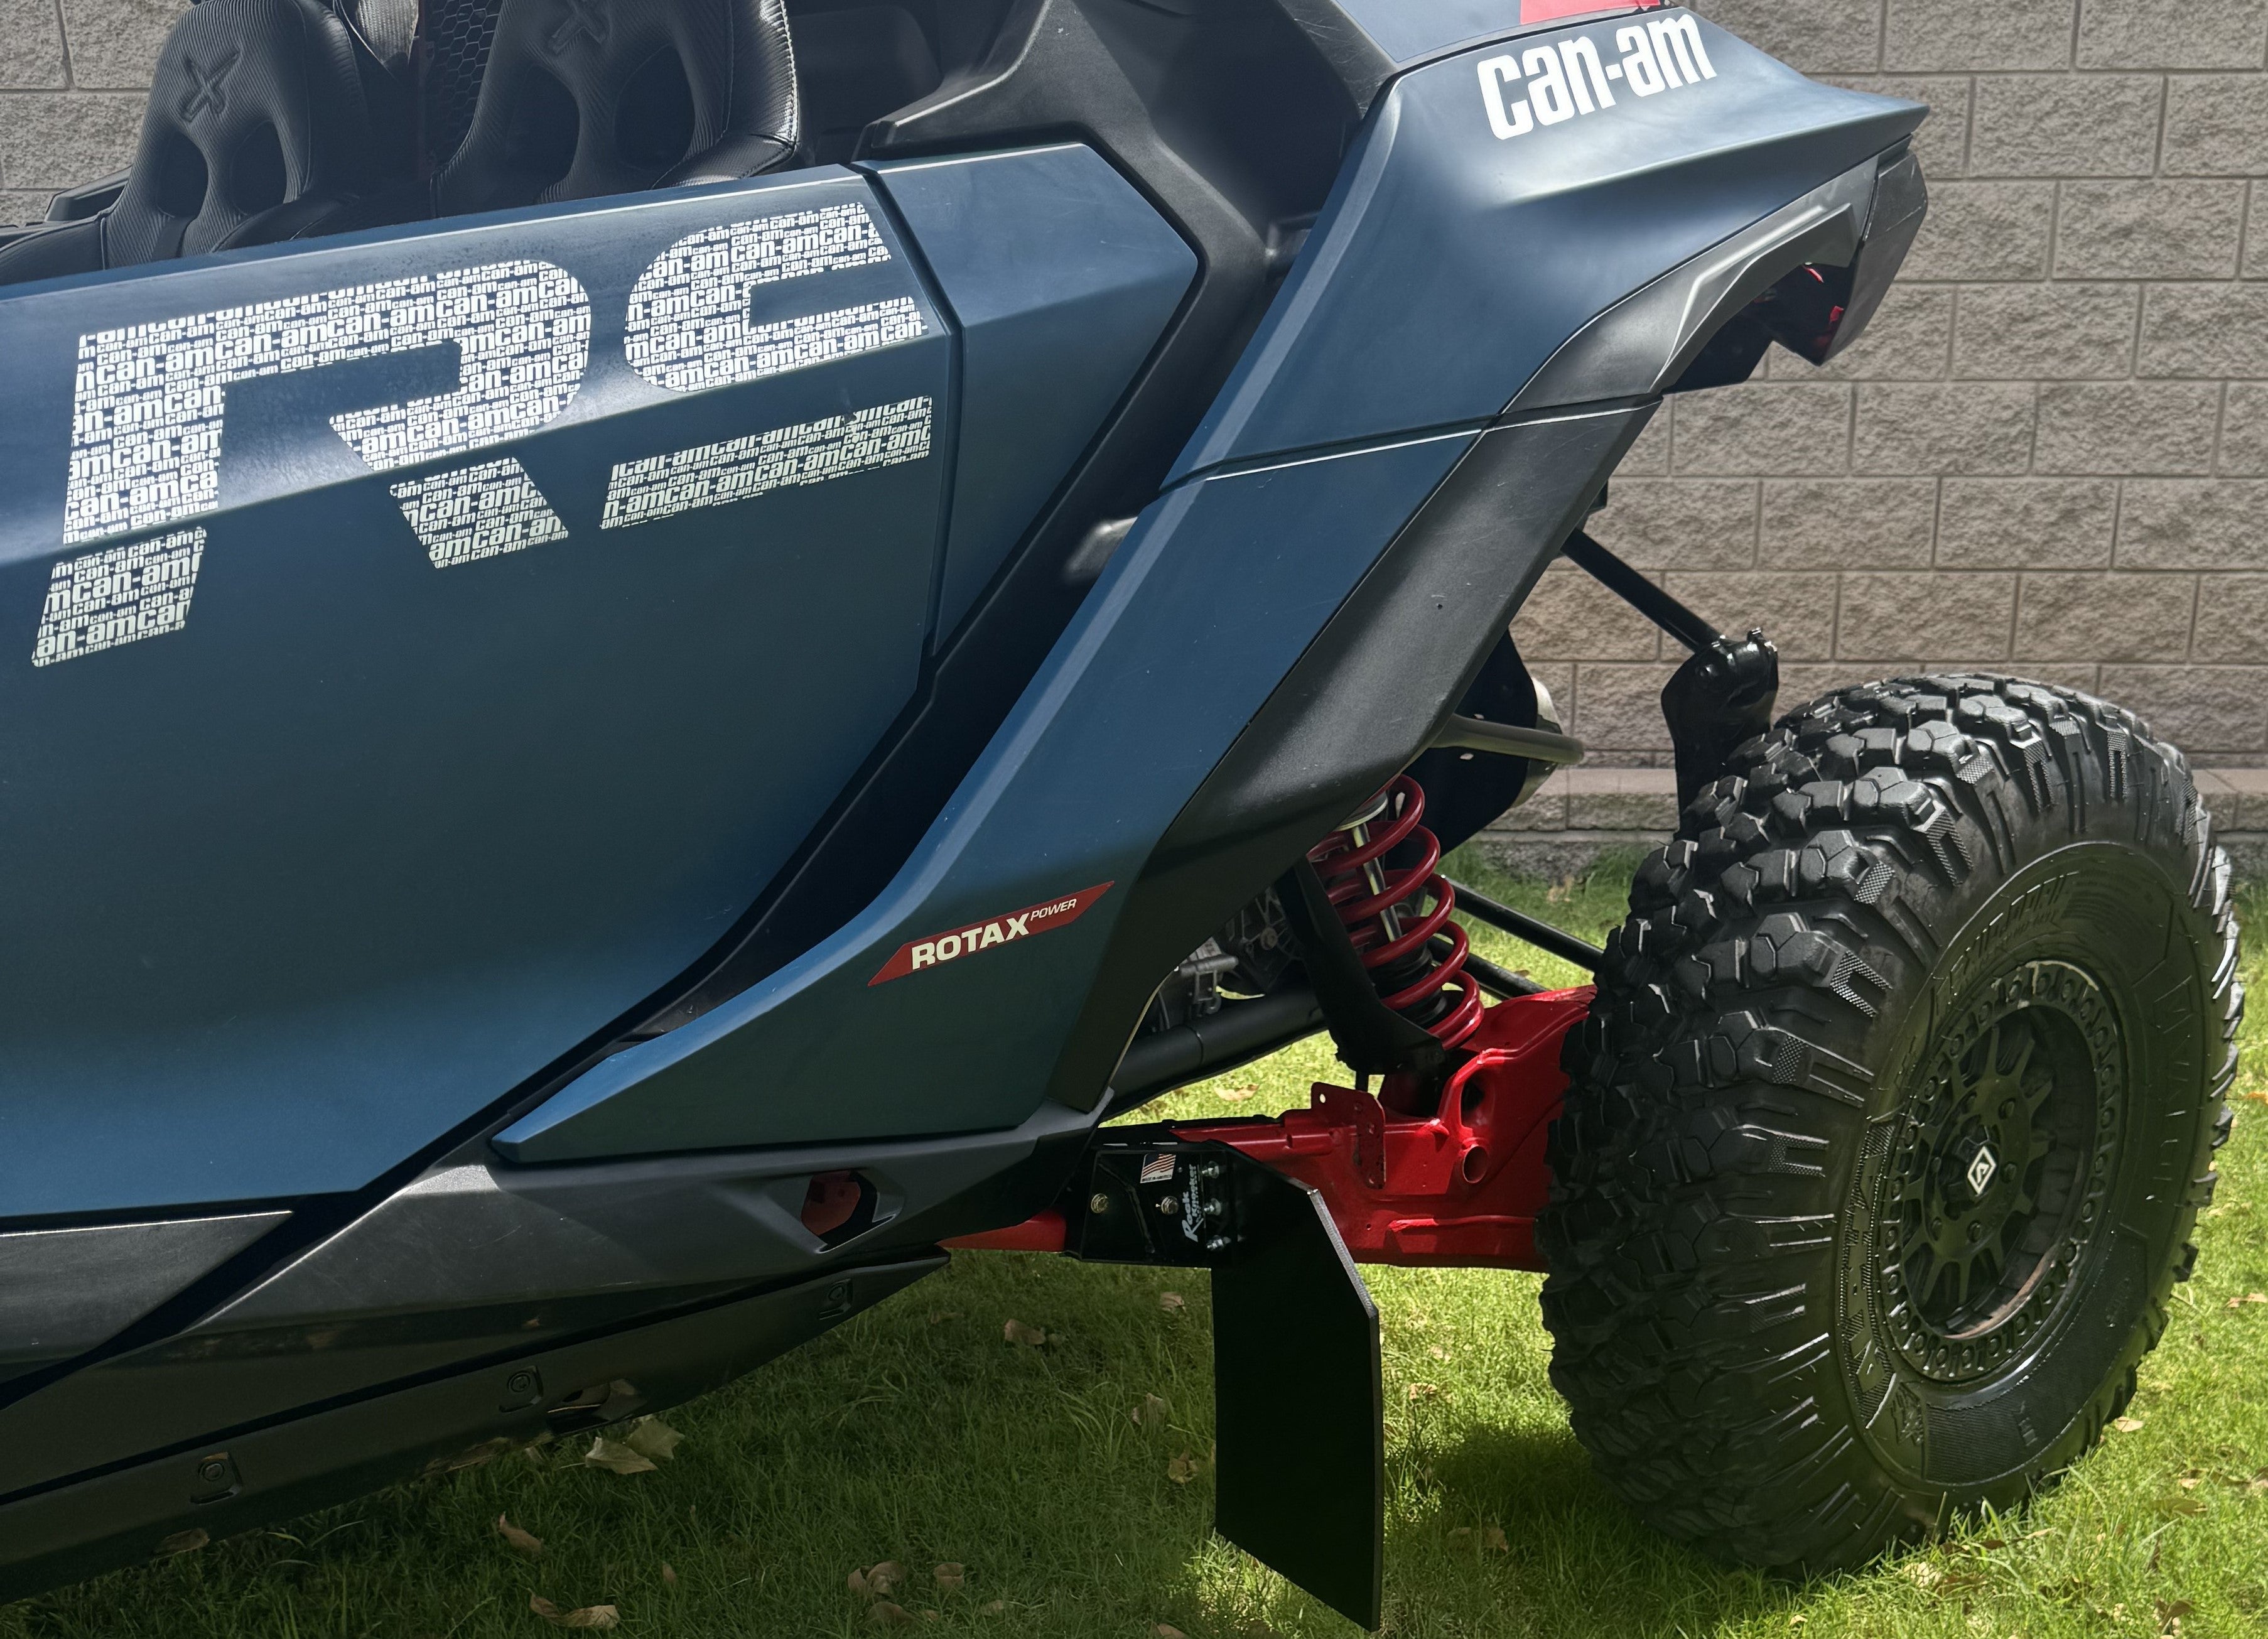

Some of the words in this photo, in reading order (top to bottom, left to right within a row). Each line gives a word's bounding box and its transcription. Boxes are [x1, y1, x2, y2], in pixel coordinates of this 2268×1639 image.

[1477, 13, 1718, 141] can-am
[819, 212, 869, 230] can-am
[731, 232, 818, 263] can-am
[638, 273, 689, 291] can-am
[691, 272, 743, 291] can-am
[149, 323, 214, 345] can-am
[264, 301, 327, 322] can-am
[215, 319, 282, 342] can-am
[327, 299, 391, 320] can-am
[436, 281, 497, 301] can-am
[691, 300, 741, 318] can-am
[96, 346, 213, 385] can-am
[215, 323, 327, 360] can-am
[327, 303, 434, 338] can-am
[436, 284, 537, 319] can-am
[495, 313, 591, 347] can-am
[650, 317, 704, 337] can-am
[650, 322, 740, 354] can-am
[97, 374, 164, 396] can-am
[215, 349, 279, 372] can-am
[328, 328, 389, 349] can-am
[437, 310, 495, 330] can-am
[97, 343, 166, 365] can-am
[165, 370, 232, 394] can-am
[281, 348, 345, 370] can-am
[391, 327, 453, 347] can-am
[495, 308, 553, 329] can-am
[495, 337, 551, 357] can-am
[651, 345, 702, 364] can-am
[704, 344, 757, 363] can-am
[704, 347, 793, 379] can-am
[795, 330, 878, 360] can-am
[345, 408, 405, 430] can-am
[452, 385, 509, 406] can-am
[408, 404, 468, 426] can-am
[509, 383, 567, 404] can-am
[881, 408, 926, 426] can-am
[113, 425, 182, 449] can-am
[407, 406, 510, 443] can-am
[408, 431, 467, 452] can-am
[618, 468, 669, 488] can-am
[710, 446, 759, 466] can-am
[797, 426, 844, 445] can-am
[758, 445, 807, 465] can-am
[840, 428, 921, 462] can-am
[114, 456, 180, 480] can-am
[667, 467, 720, 487] can-am
[754, 448, 839, 482] can-am
[838, 452, 883, 470] can-am
[65, 479, 178, 521] can-am
[422, 482, 482, 504] can-am
[664, 470, 753, 504] can-am
[752, 472, 801, 492] can-am
[129, 496, 180, 515] can-am
[131, 502, 200, 527] can-am
[419, 485, 521, 522] can-am
[419, 512, 475, 534] can-am
[477, 502, 519, 519] can-am
[662, 494, 713, 514] can-am
[80, 522, 127, 539] can-am
[475, 509, 533, 531] can-am
[74, 550, 125, 571] can-am
[127, 531, 192, 558] can-am
[471, 537, 526, 560] can-am
[72, 556, 190, 604] can-am
[74, 556, 143, 583] can-am
[144, 546, 190, 566] can-am
[72, 588, 139, 615] can-am
[141, 576, 190, 596] can-am
[90, 605, 136, 625] can-am
[85, 634, 136, 654] can-am
[910, 912, 1030, 971] ROTAX
[1030, 898, 1077, 921] POWER
